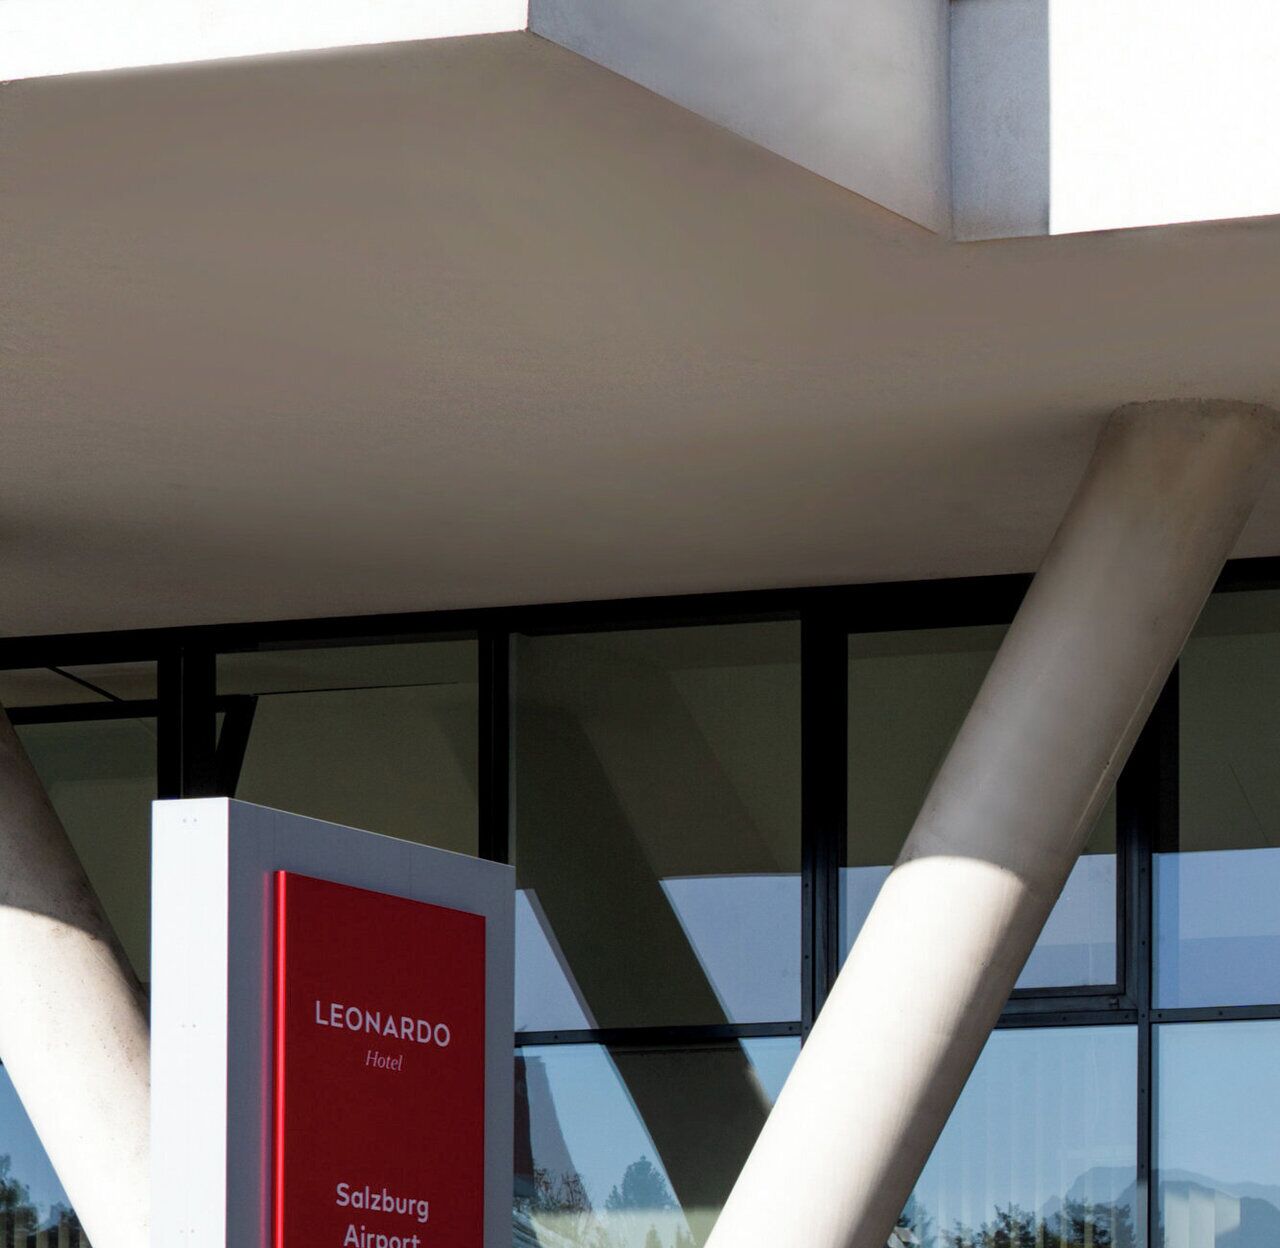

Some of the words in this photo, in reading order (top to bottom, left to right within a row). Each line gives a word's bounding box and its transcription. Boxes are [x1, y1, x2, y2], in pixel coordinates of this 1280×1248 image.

[315, 1000, 451, 1048] LEONARDO
[365, 1049, 403, 1071] Hotel
[335, 1182, 429, 1223] Salzburg
